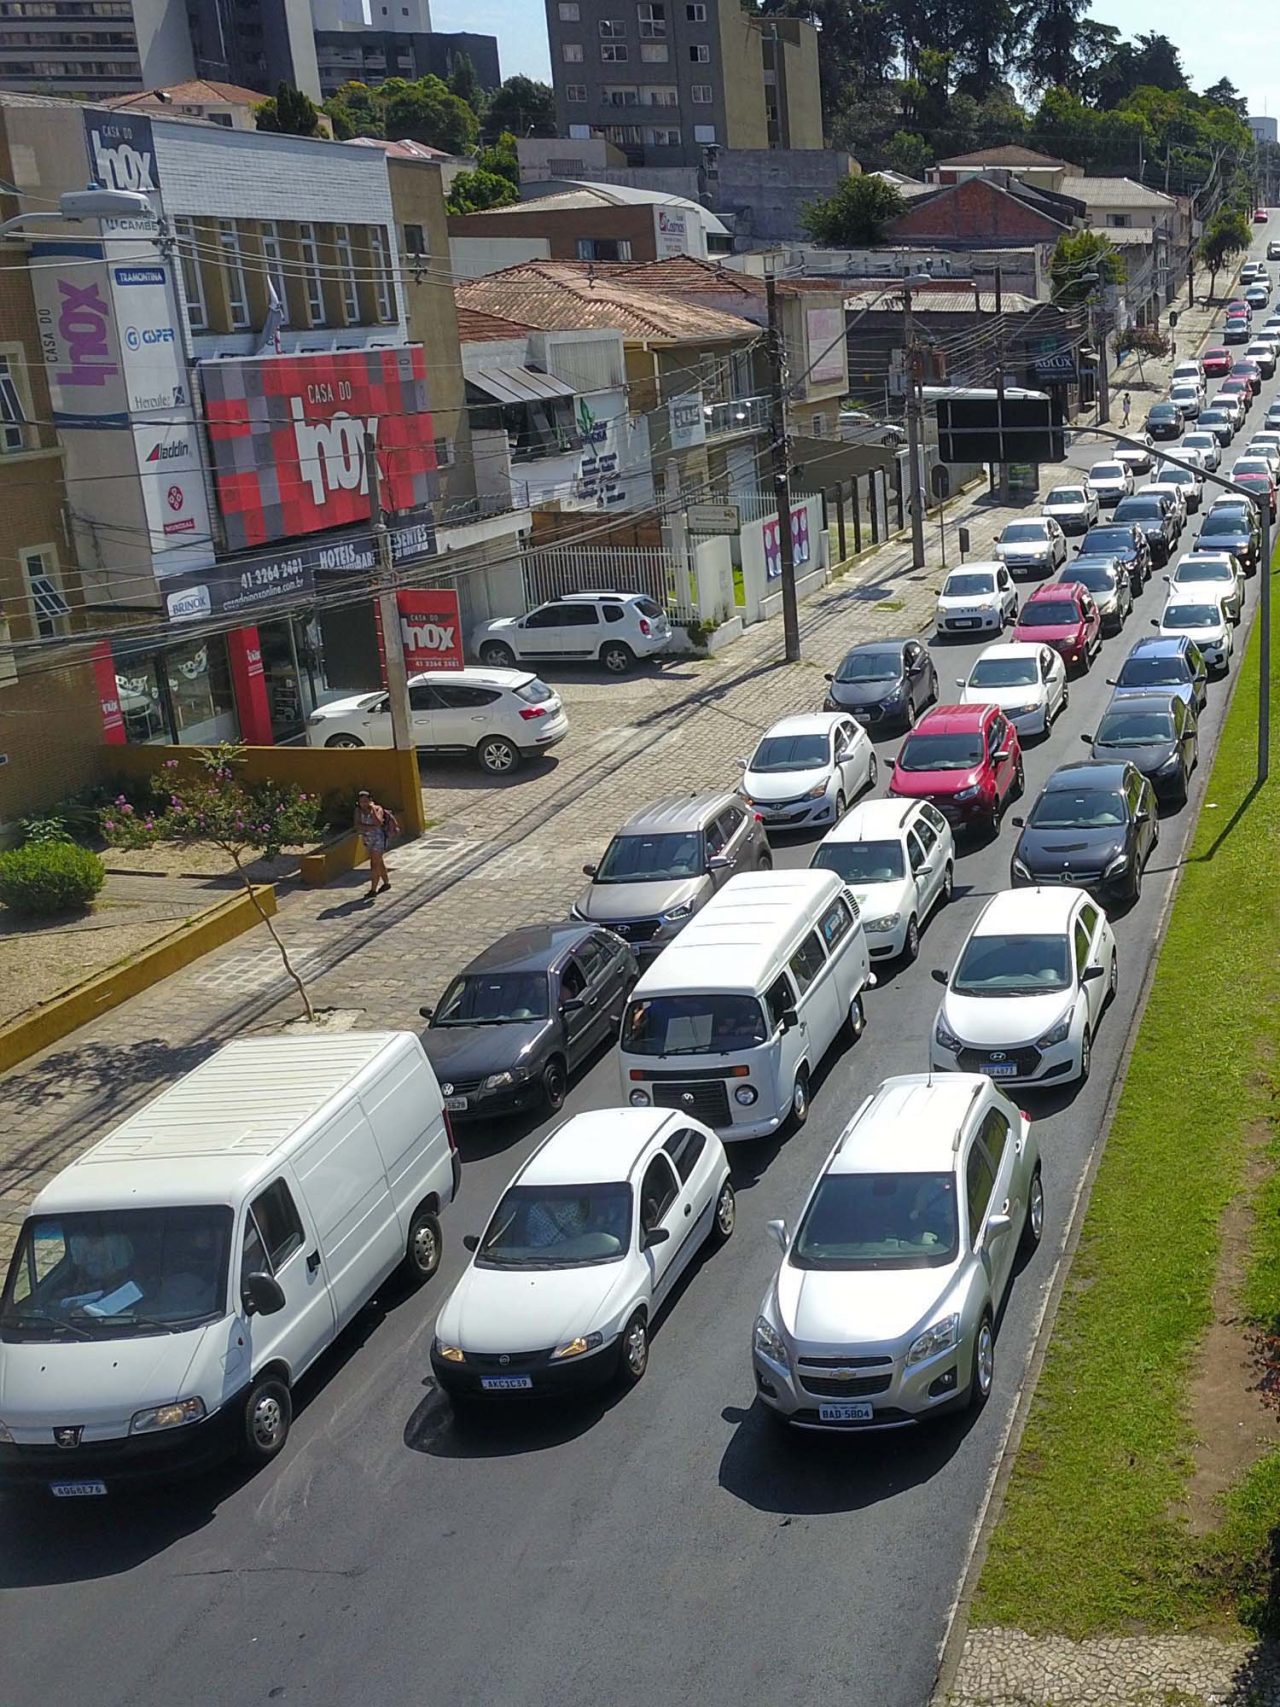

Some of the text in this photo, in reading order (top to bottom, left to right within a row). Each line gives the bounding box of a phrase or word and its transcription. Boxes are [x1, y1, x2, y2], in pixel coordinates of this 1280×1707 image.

[103, 125, 119, 137] CASA
[119, 272, 162, 281] TRAMONTINA
[39, 308, 59, 363] CASA DO
[307, 380, 352, 404] CASA DO
[241, 573, 252, 589] 41
[172, 596, 206, 615] BRINOX
